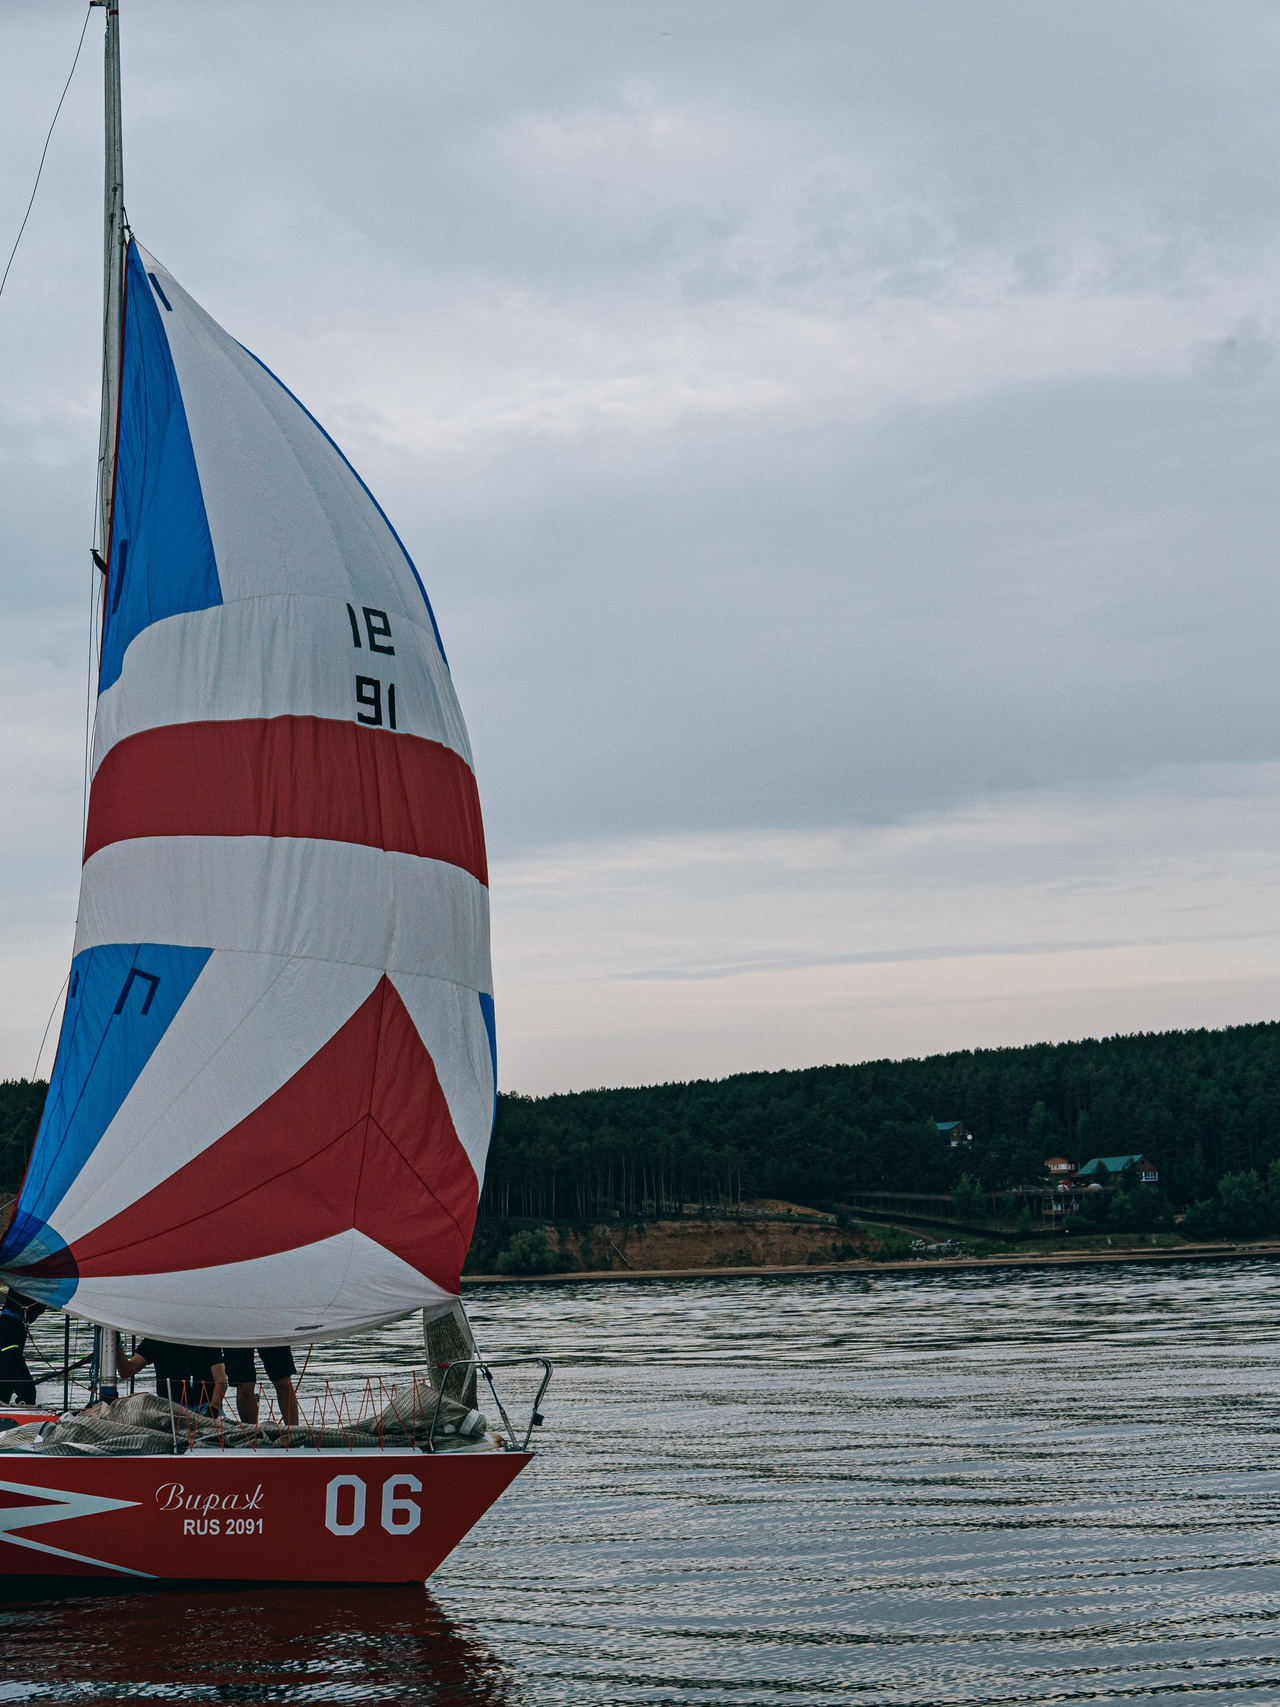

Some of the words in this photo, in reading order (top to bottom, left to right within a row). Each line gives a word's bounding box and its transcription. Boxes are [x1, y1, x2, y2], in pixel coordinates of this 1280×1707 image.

[355, 674, 397, 730] 91
[155, 1482, 265, 1517] Вираж
[325, 1474, 423, 1536] 06
[183, 1519, 220, 1535] RUS
[225, 1518, 264, 1535] 2091
